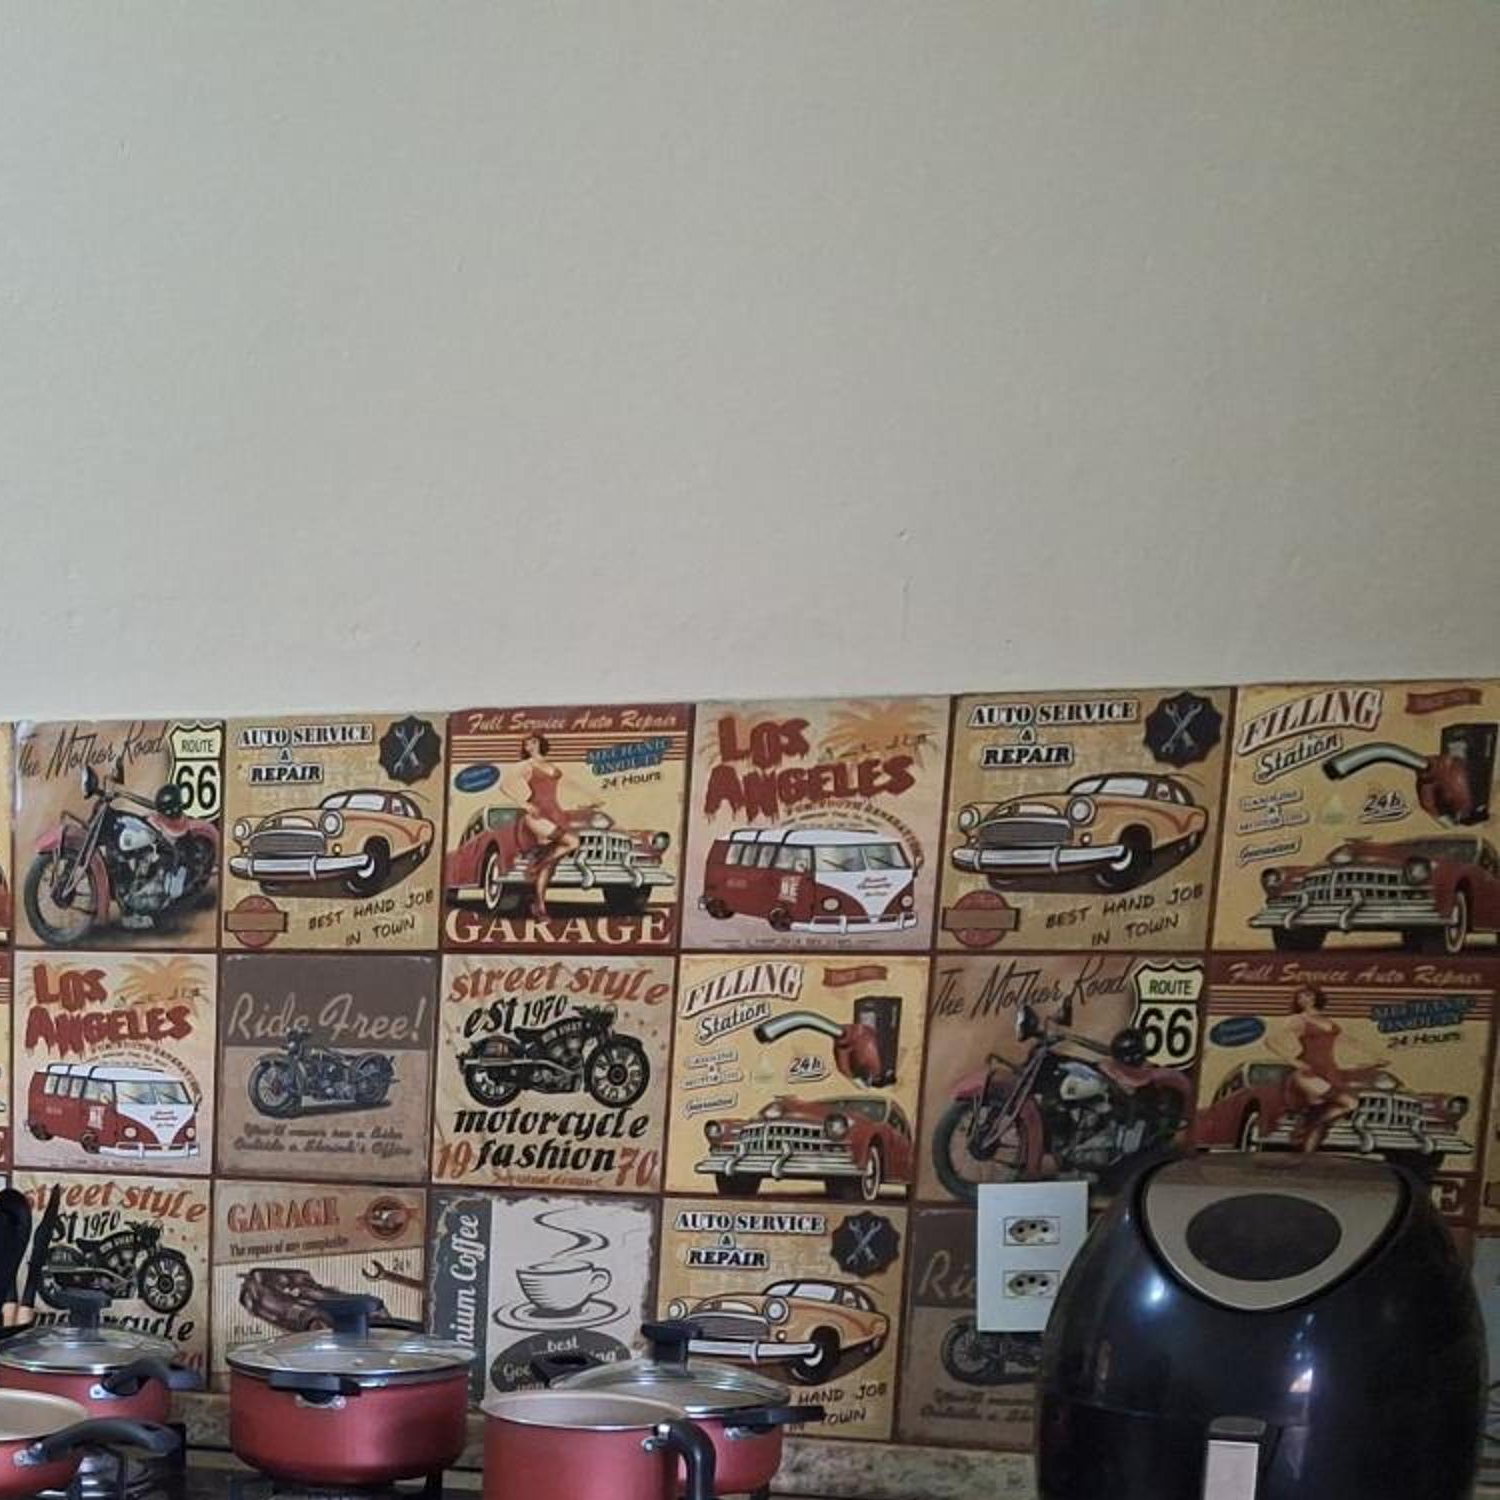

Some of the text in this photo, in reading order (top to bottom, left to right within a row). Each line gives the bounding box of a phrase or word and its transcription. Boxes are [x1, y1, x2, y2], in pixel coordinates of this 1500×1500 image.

[468, 710, 677, 733] Full Service Auto Repair
[969, 701, 1138, 727] AUTO SERVICE
[1242, 690, 1379, 748] FILLING
[117, 722, 168, 768] Road
[180, 738, 215, 754] ROUTE
[238, 726, 372, 746] AUTO SERVICE
[717, 717, 810, 767] LOS
[251, 766, 322, 783] REPAIR
[982, 745, 1074, 767] REPAIR
[1257, 733, 1339, 781] Station
[176, 765, 218, 811] 66
[601, 771, 662, 789] 24 Hours
[703, 756, 916, 822] ANGELES
[307, 890, 435, 931] BEST HAND JOB
[445, 907, 673, 945] GARAGE
[1046, 884, 1204, 930] BEST HAND JOB
[345, 917, 416, 946] IN TOWN
[1091, 914, 1180, 947] IN TOWN
[31, 963, 108, 1010] LOS
[448, 960, 671, 1006] street style
[684, 963, 800, 1013] FILLING
[932, 956, 1132, 1021] The Mother Road
[1148, 978, 1194, 997] ROUTE
[1227, 963, 1271, 985] Full
[1355, 963, 1405, 984] Auto
[1412, 964, 1483, 986] Repair
[25, 1004, 193, 1056] ANGELES
[227, 993, 428, 1042] Ride Free!
[522, 995, 568, 1028] 1970
[699, 1001, 769, 1041] Station
[1139, 1006, 1196, 1059] 66
[453, 1106, 650, 1142] motorcycle
[435, 1140, 473, 1179] 19
[471, 1137, 616, 1173] fashion
[122, 1184, 207, 1223] style
[676, 1212, 827, 1233] AUTO SERVICE
[82, 1211, 121, 1239] 1970
[451, 1214, 487, 1281] Coffee
[687, 1250, 767, 1268] REPAIR
[856, 1382, 888, 1401] JOB
